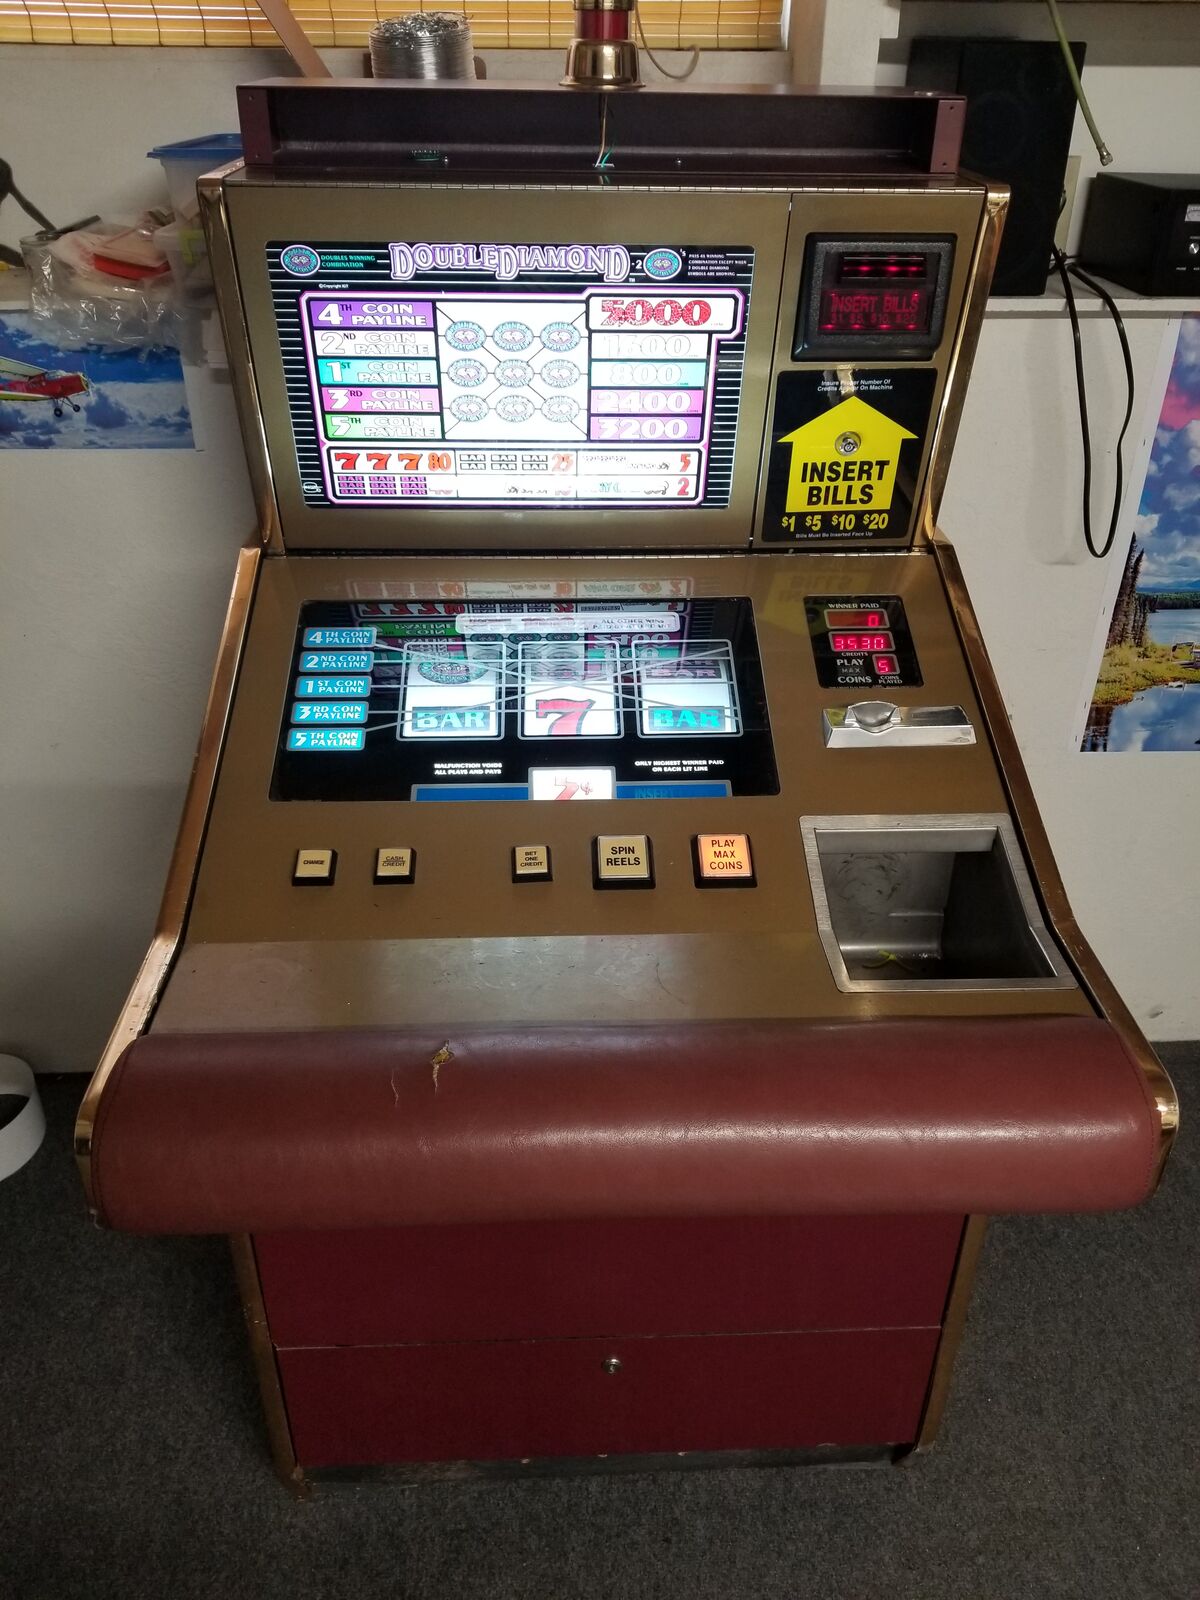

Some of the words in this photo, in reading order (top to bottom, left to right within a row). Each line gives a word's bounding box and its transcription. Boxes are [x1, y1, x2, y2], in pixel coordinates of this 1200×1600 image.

[361, 303, 414, 314] COIN
[832, 295, 878, 312] INSERT
[883, 294, 919, 312] BILLS
[600, 299, 712, 326] 5000
[352, 315, 427, 326] PAYLINE
[364, 332, 417, 344] COIN
[354, 344, 430, 355] PAYLINE
[368, 361, 419, 372] COIN
[357, 372, 432, 384] PAYLINE
[610, 364, 682, 385] 800
[370, 389, 420, 400] COIN
[361, 400, 434, 410] PAYLINE
[597, 391, 692, 412] 2400
[373, 416, 423, 426] COIN
[364, 426, 436, 437] PAYLINE
[598, 418, 688, 438] 3200
[334, 452, 360, 470] 7
[366, 452, 392, 470] 7
[398, 453, 423, 470] 7
[428, 452, 452, 471] 80
[680, 454, 692, 472] 5
[801, 460, 890, 483] INSERT
[677, 477, 690, 496] 2
[806, 484, 874, 506] BILLS
[782, 516, 796, 532] $1
[806, 514, 822, 531] $5
[832, 514, 856, 530] $10
[862, 513, 889, 530] $20
[868, 614, 879, 627] 0
[836, 658, 864, 666] PLAY
[878, 660, 888, 672] 5
[838, 676, 872, 684] COINS
[416, 711, 486, 728] BAR
[653, 708, 720, 728] BAR
[536, 698, 596, 735] 7
[712, 840, 736, 848] PLAY
[610, 846, 636, 855] SPIN
[714, 850, 736, 858] MAX
[606, 857, 640, 866] REELS
[710, 860, 743, 870] COINS
